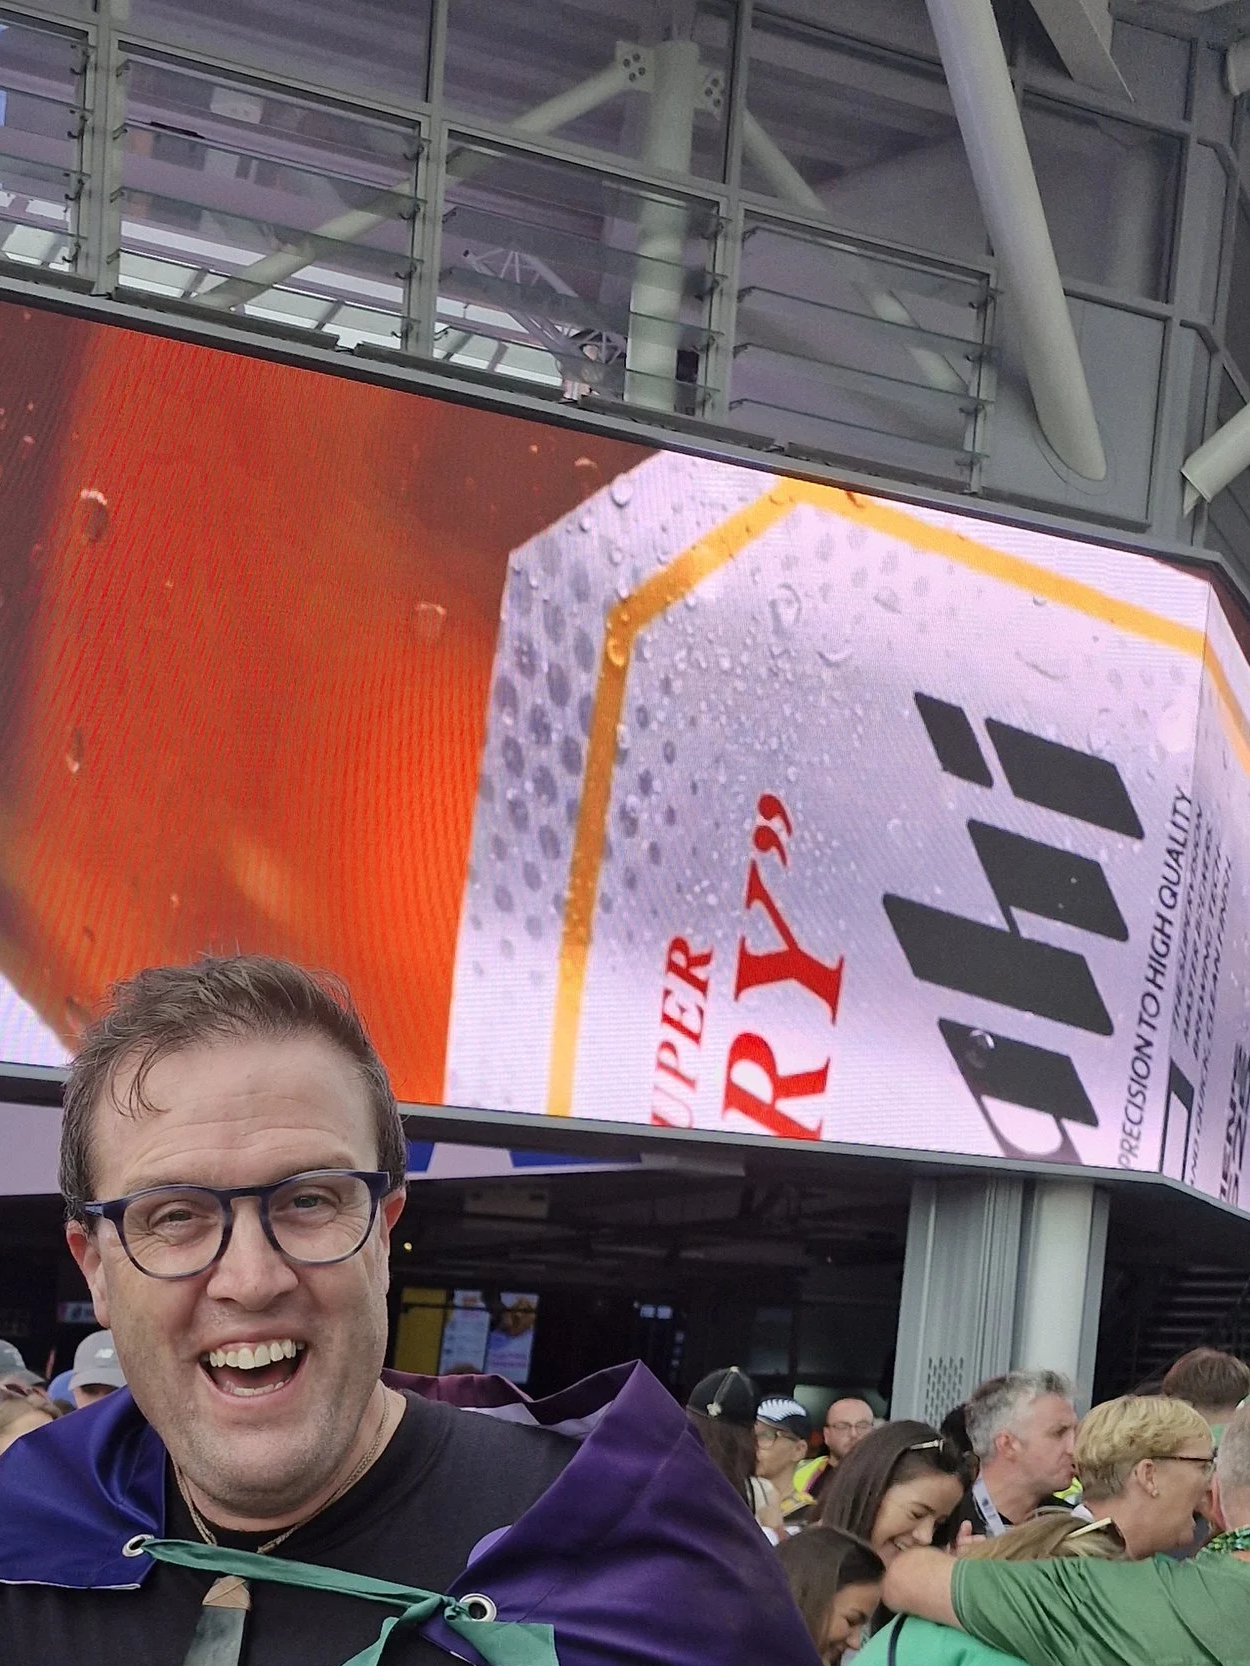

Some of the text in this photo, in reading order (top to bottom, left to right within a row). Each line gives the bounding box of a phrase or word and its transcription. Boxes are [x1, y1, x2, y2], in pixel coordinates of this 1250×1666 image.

[1118, 785, 1193, 1169] PRECISION TO HIGH QUALITY
